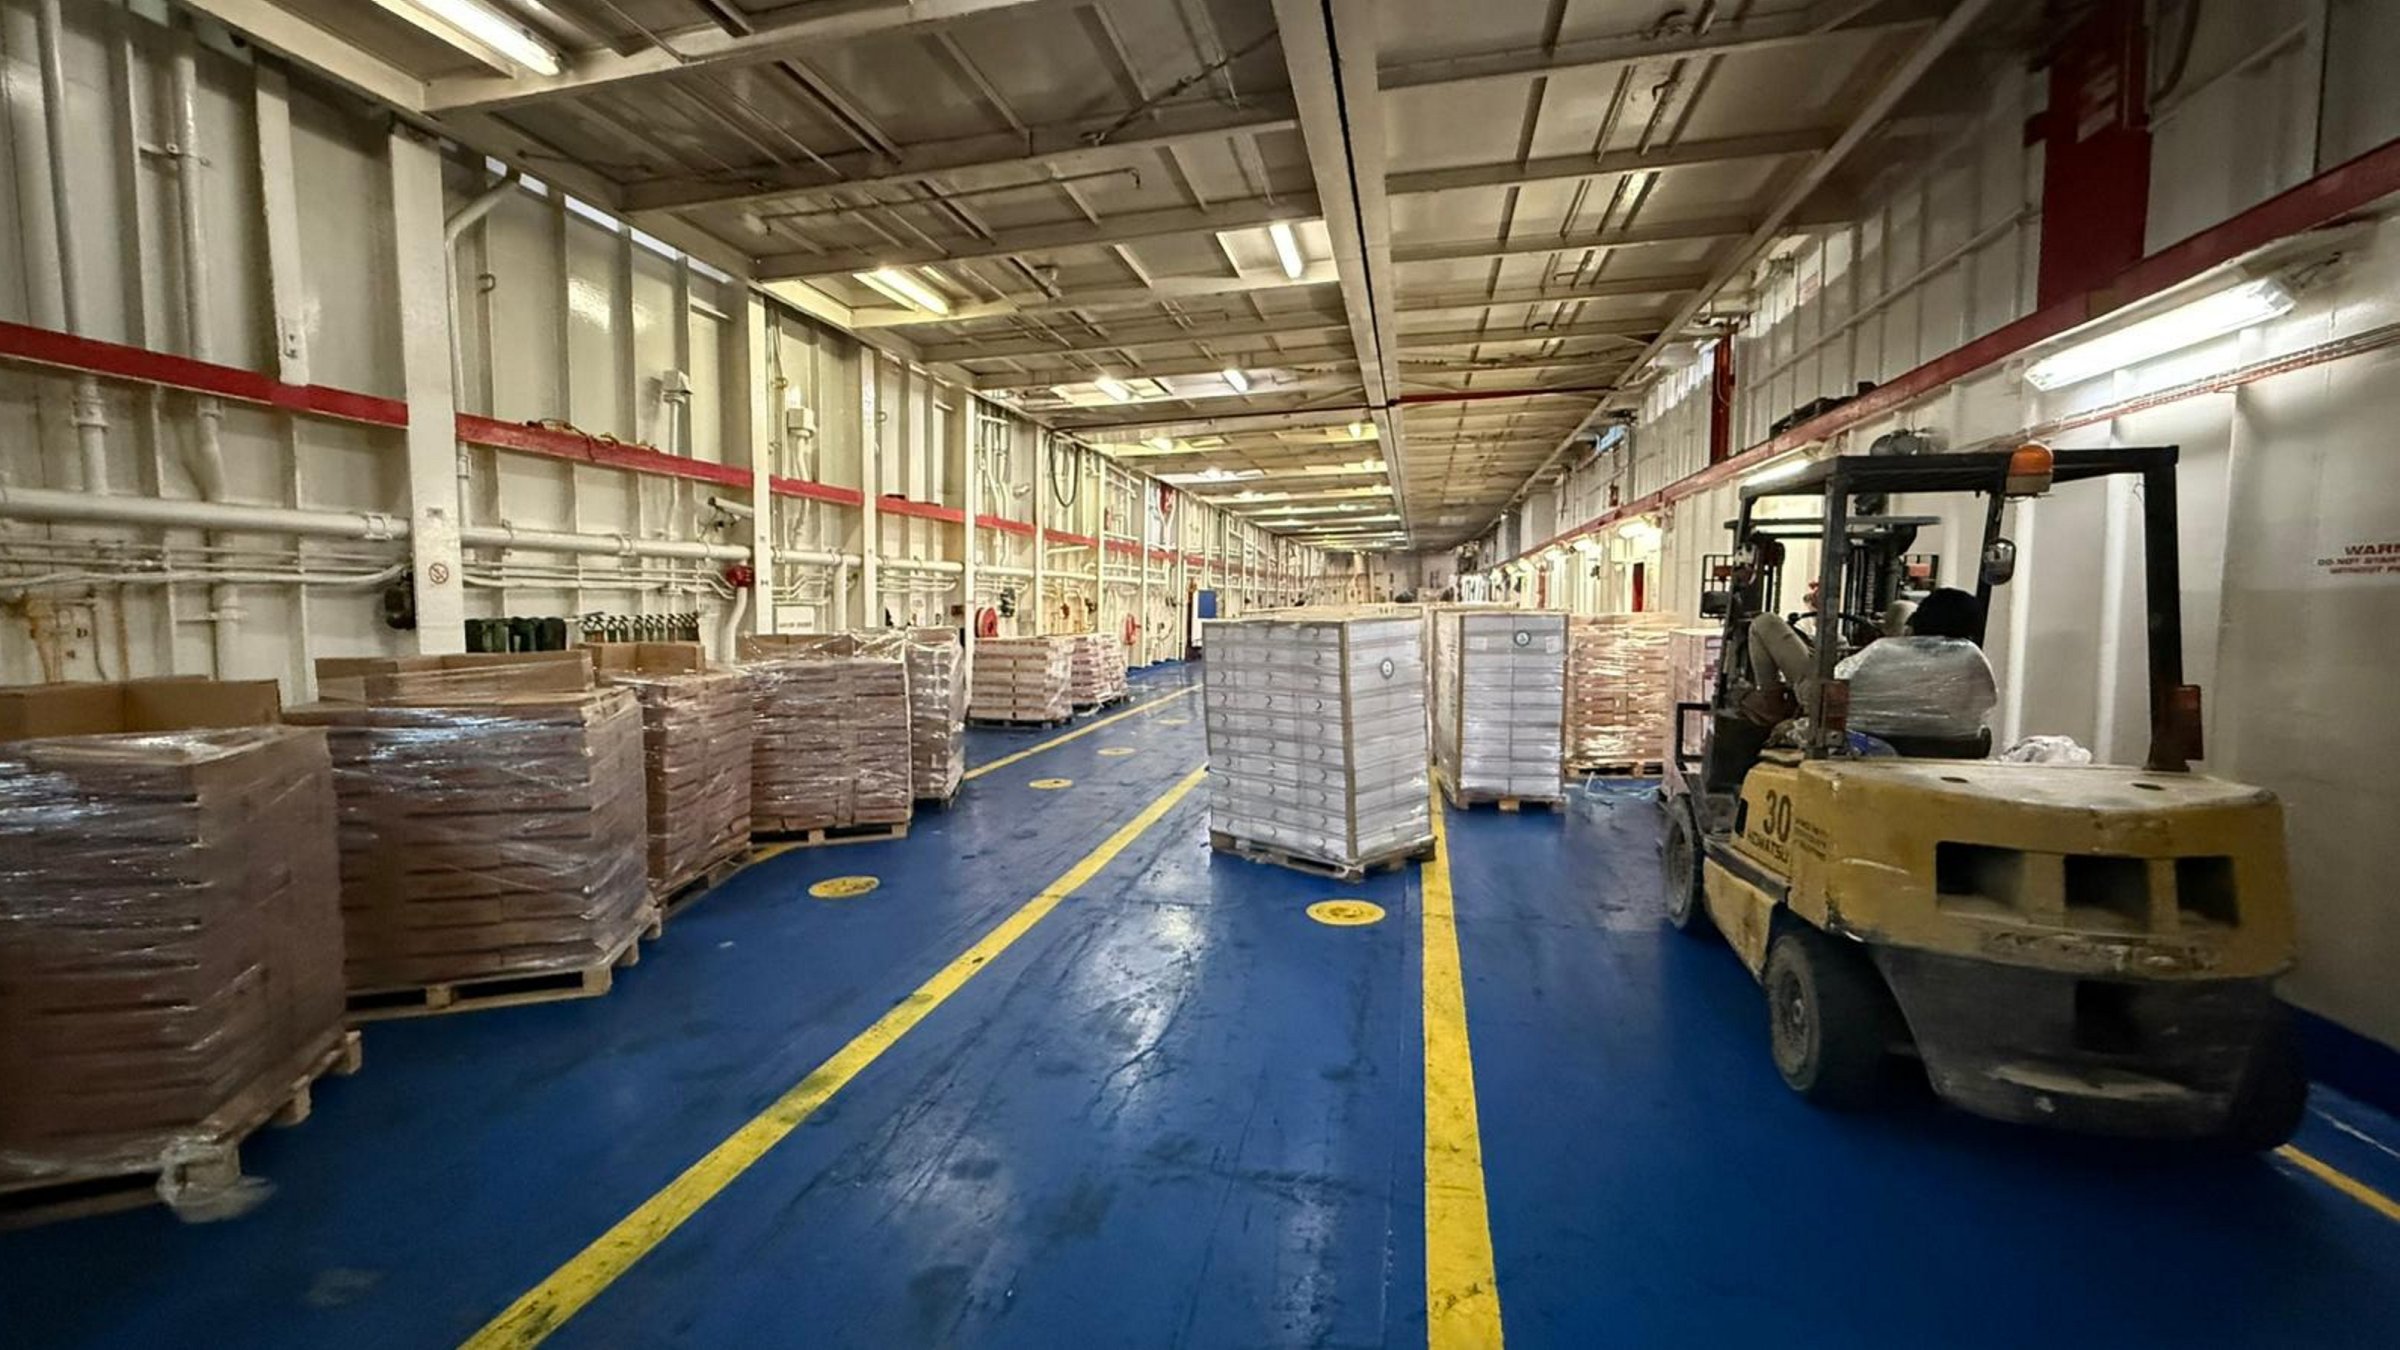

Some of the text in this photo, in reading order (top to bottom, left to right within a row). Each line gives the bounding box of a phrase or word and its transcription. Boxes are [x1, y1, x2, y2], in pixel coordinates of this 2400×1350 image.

[2317, 558, 2335, 567] DO
[2337, 557, 2359, 566] NOT
[1762, 788, 1792, 843] 30
